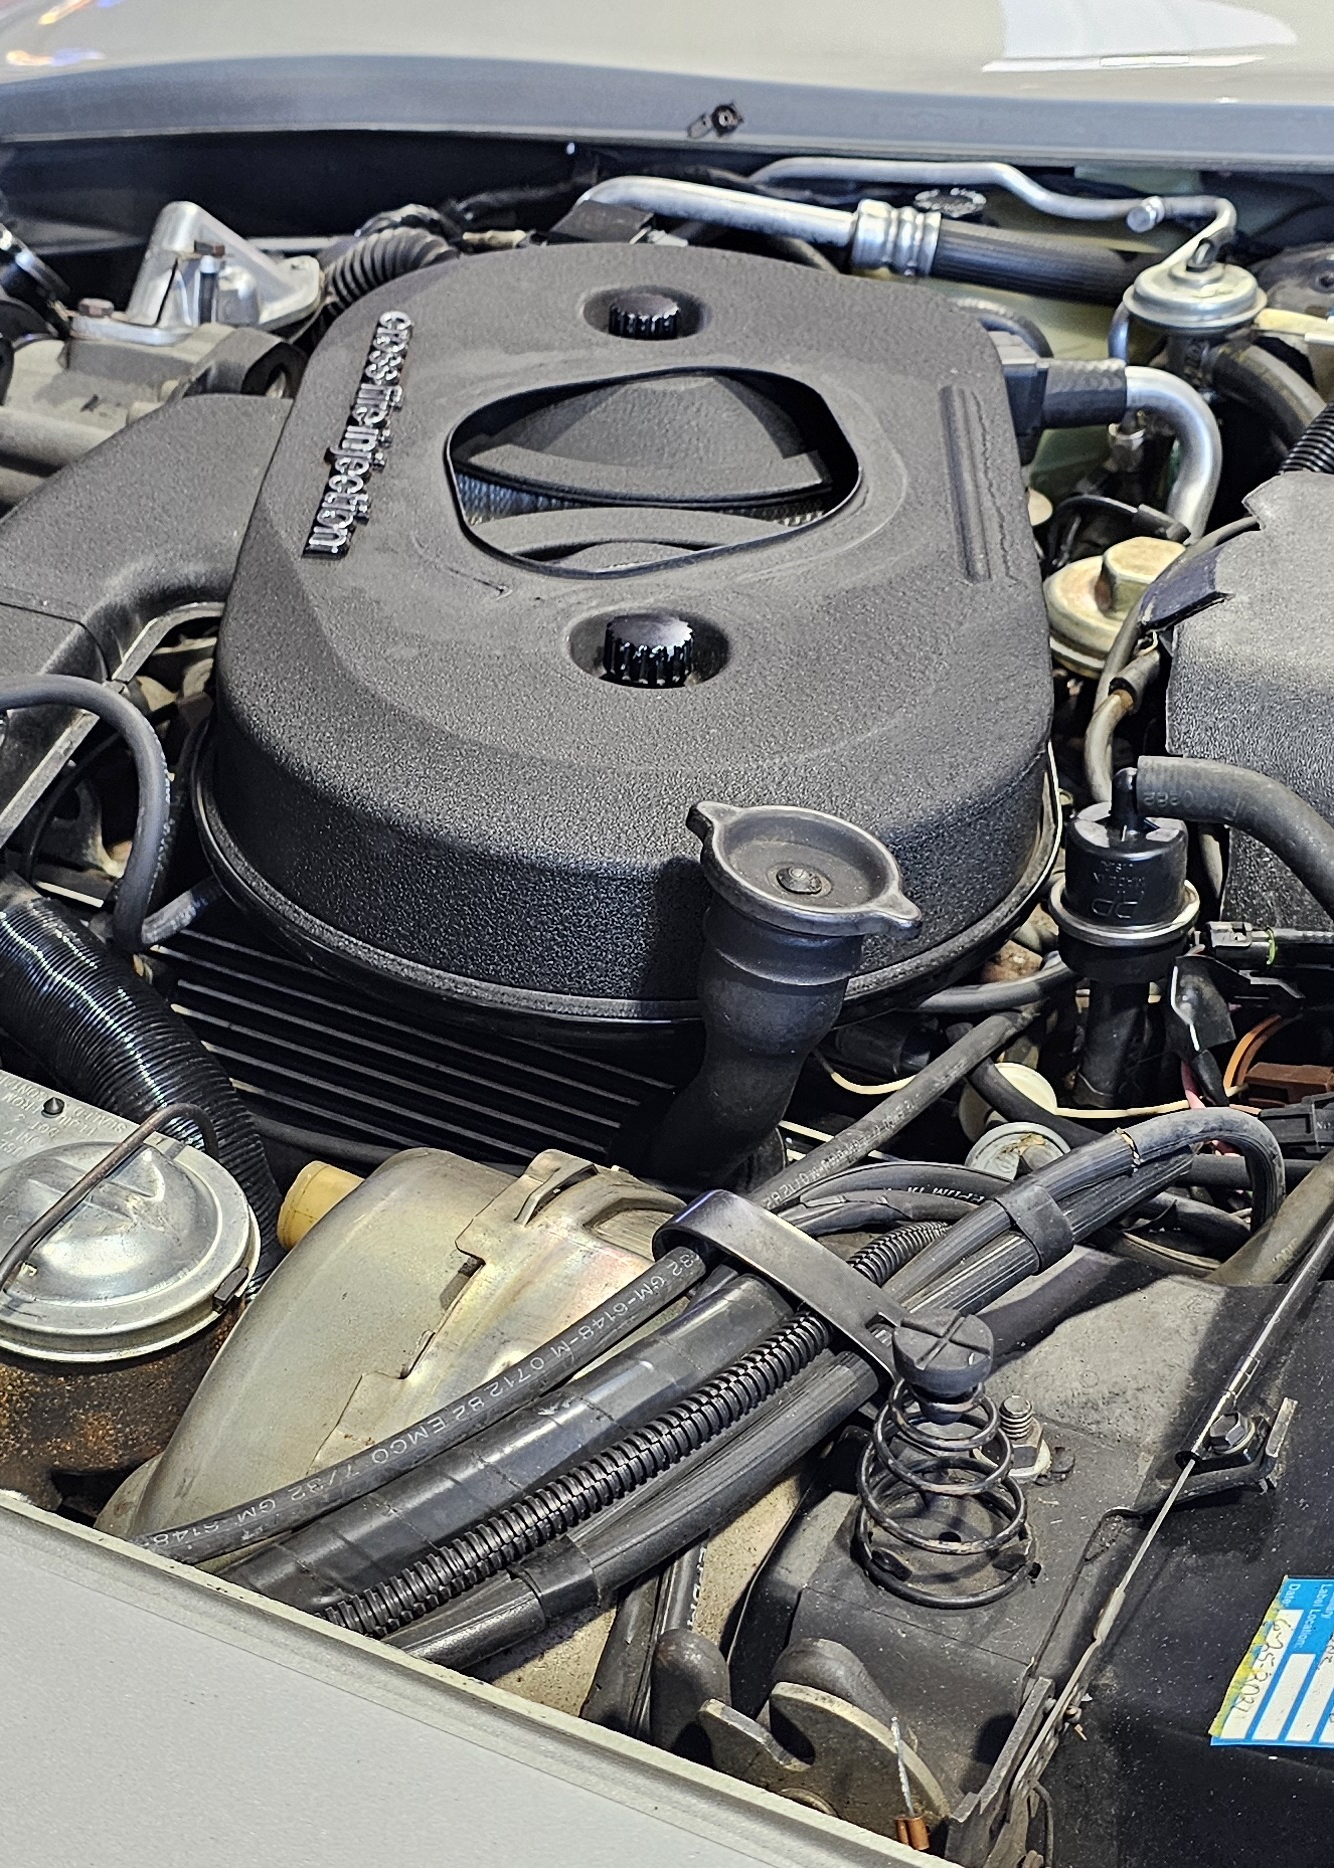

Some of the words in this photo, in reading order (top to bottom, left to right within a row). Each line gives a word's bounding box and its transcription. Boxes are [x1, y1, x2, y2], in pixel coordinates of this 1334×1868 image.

[371, 1416, 447, 1465] EMCO
[287, 1462, 360, 1502] 7/32
[1279, 1583, 1301, 1607] Date:
[1311, 1583, 1333, 1606] Label
[1293, 1608, 1321, 1648] Location:
